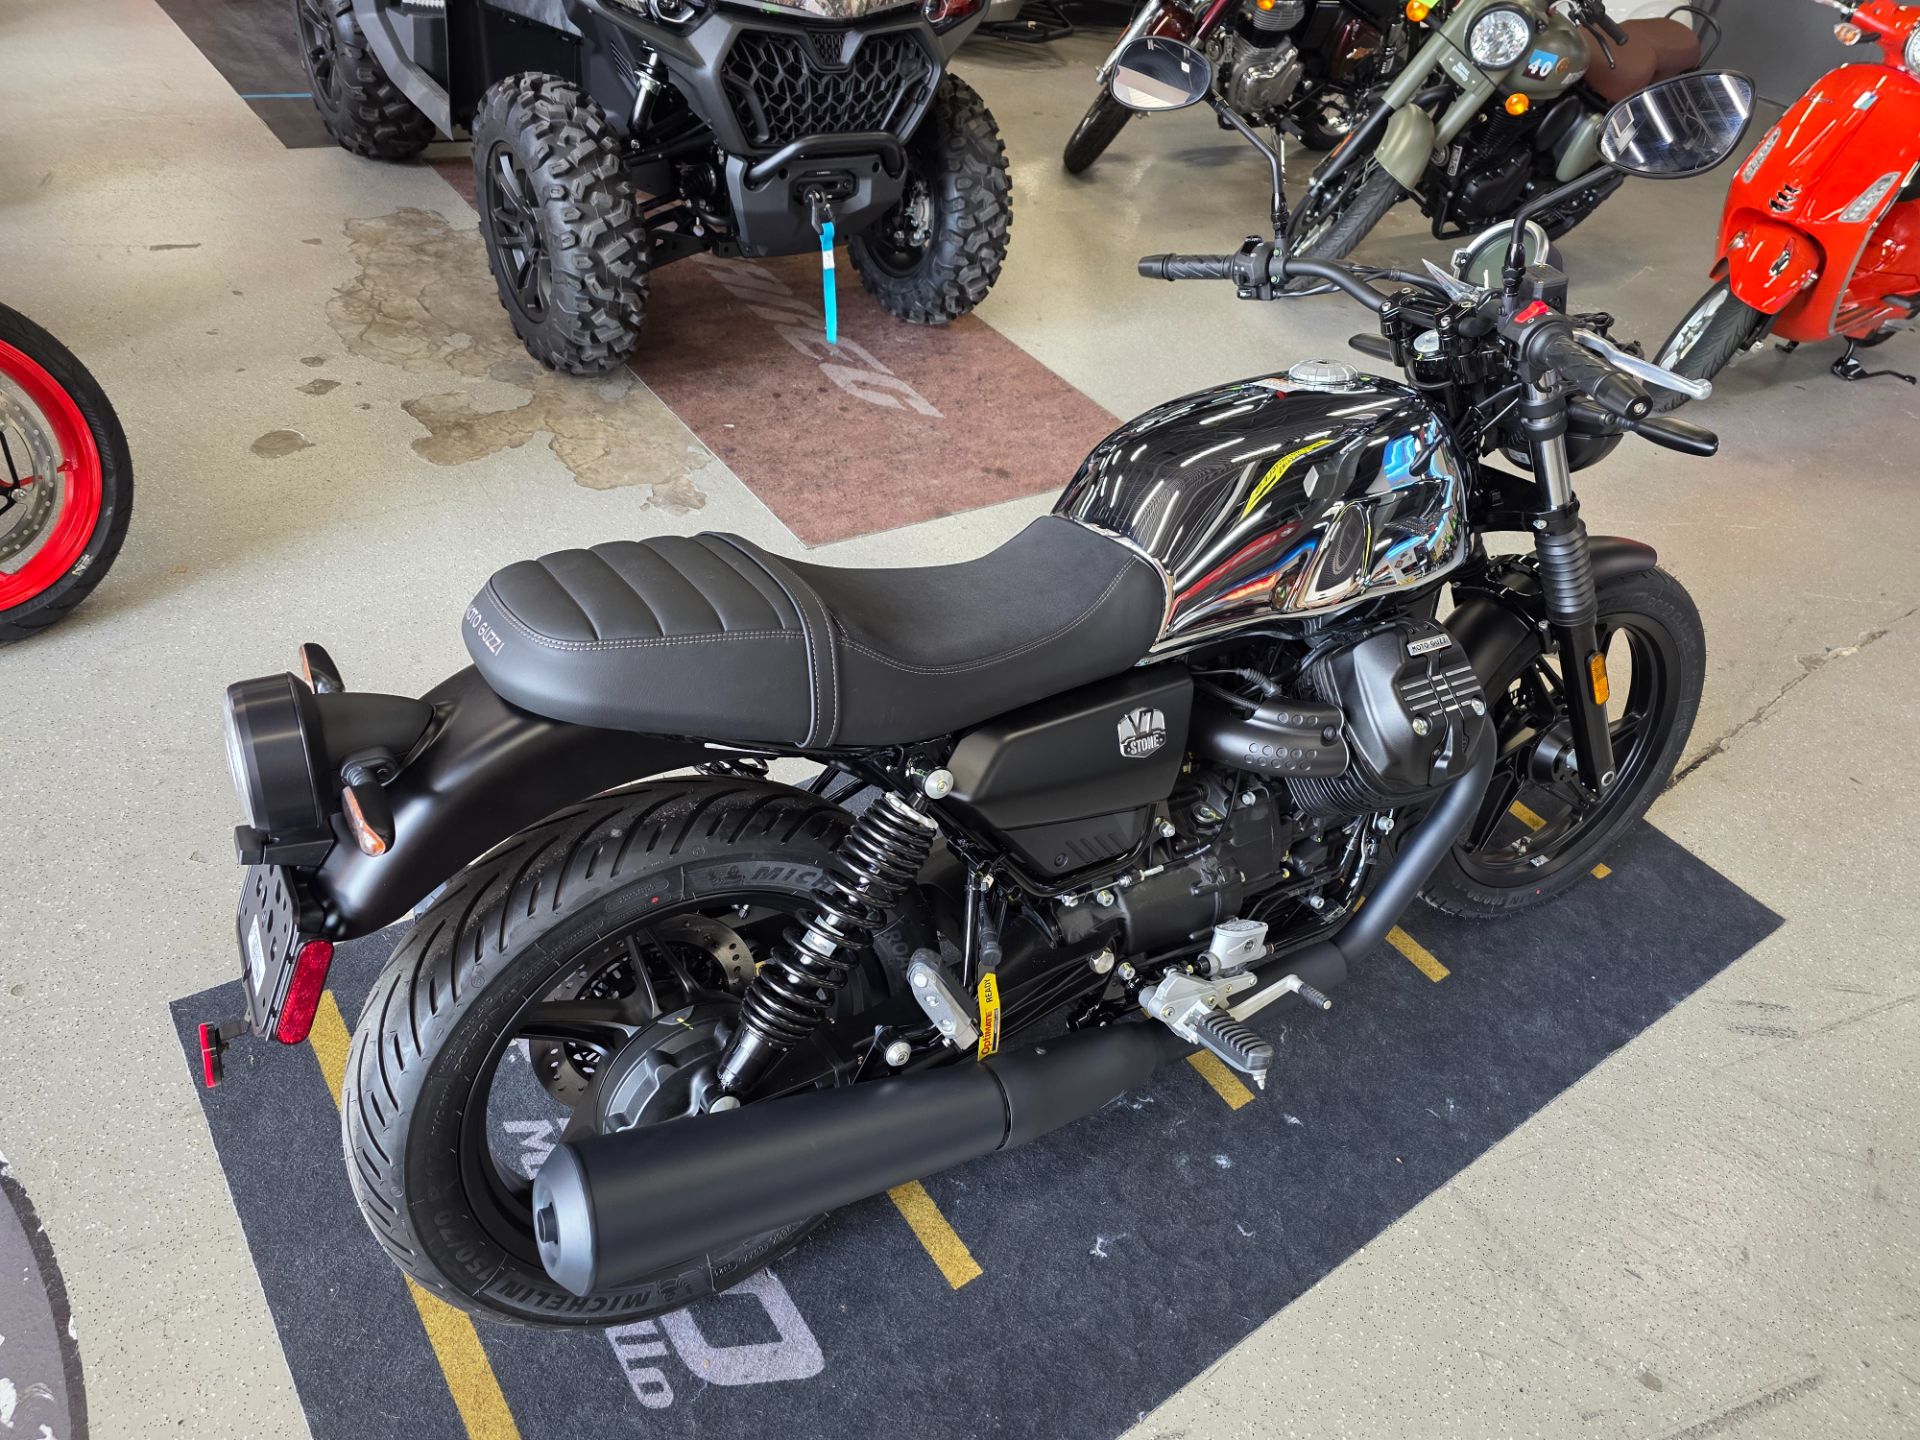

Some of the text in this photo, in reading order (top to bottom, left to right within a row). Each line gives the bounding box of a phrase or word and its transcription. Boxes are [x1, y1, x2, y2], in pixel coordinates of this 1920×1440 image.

[1528, 58, 1553, 77] 40
[478, 622, 504, 656] GUZZI
[1411, 642, 1430, 652] MOTO
[1129, 734, 1160, 755] STONE
[983, 978, 994, 1003] READY
[495, 1277, 651, 1314] MICHELIN
